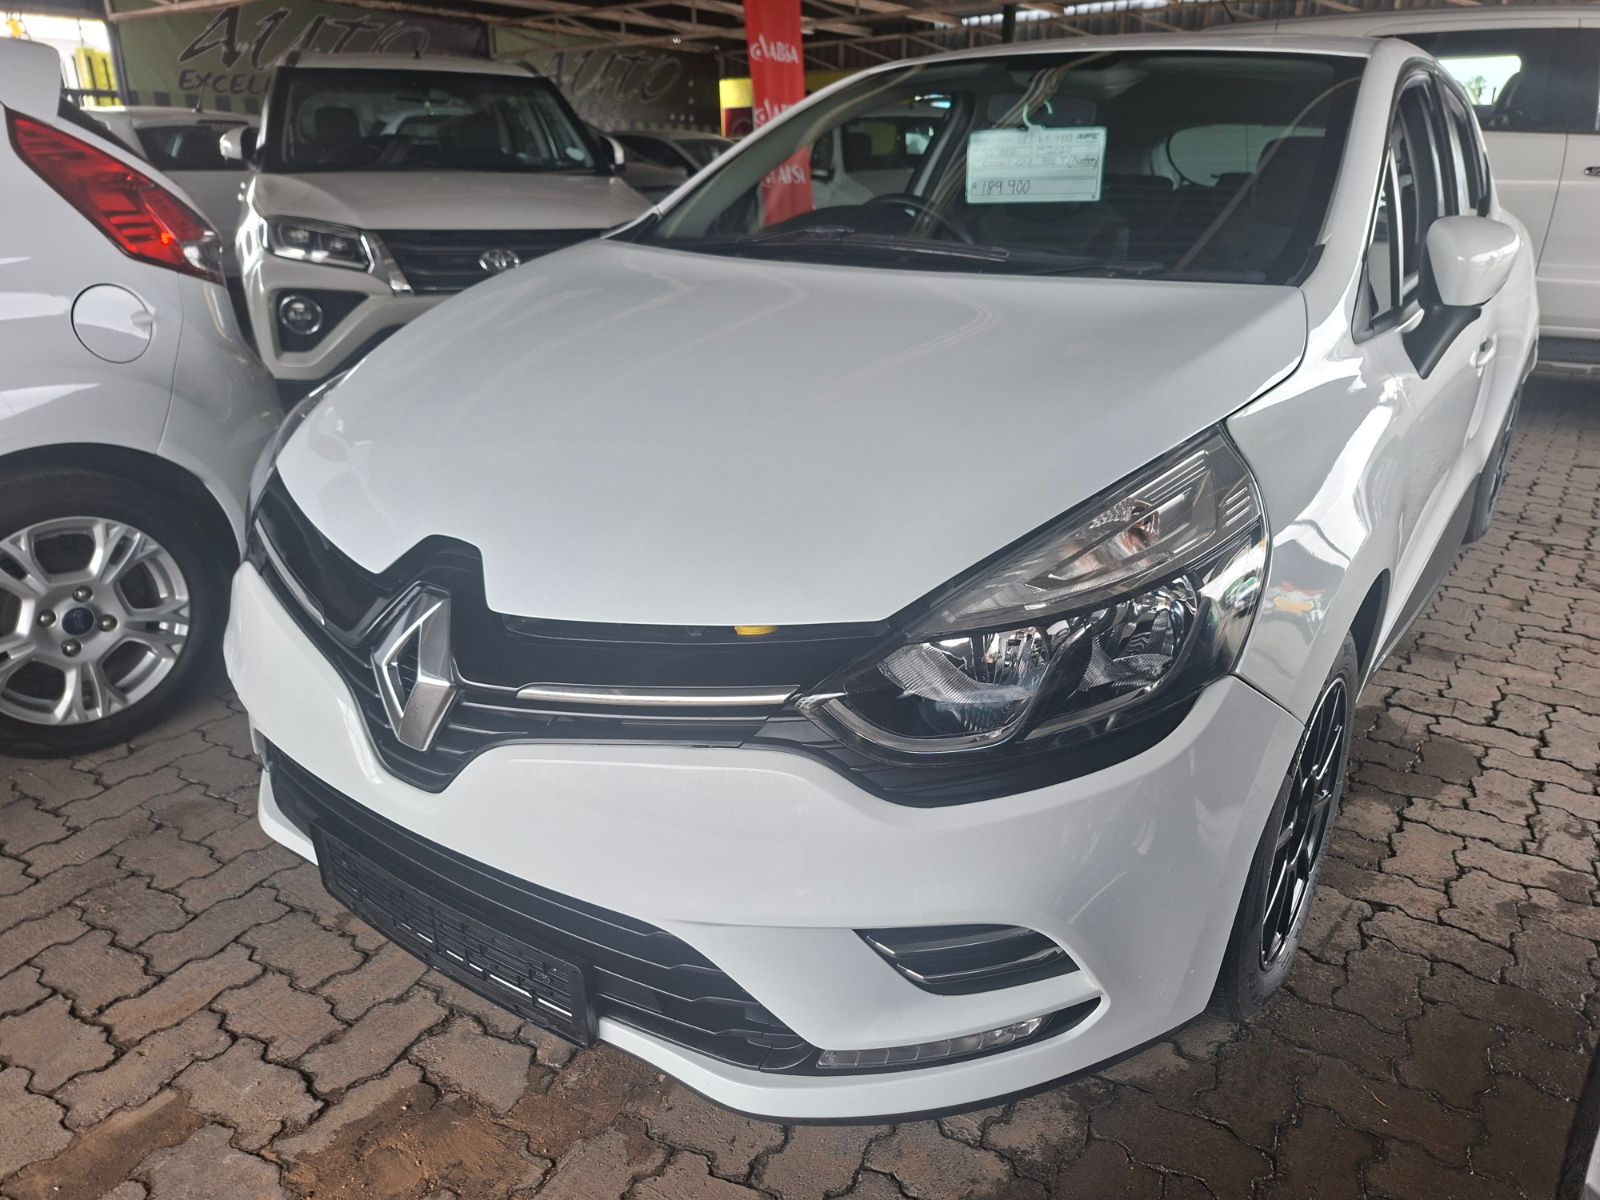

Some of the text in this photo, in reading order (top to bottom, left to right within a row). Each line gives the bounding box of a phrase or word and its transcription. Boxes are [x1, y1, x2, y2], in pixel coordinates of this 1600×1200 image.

[176, 5, 432, 72] AUTO
[543, 49, 682, 105] AUTO
[981, 180, 1003, 196] 189
[1007, 179, 1031, 196] 900
